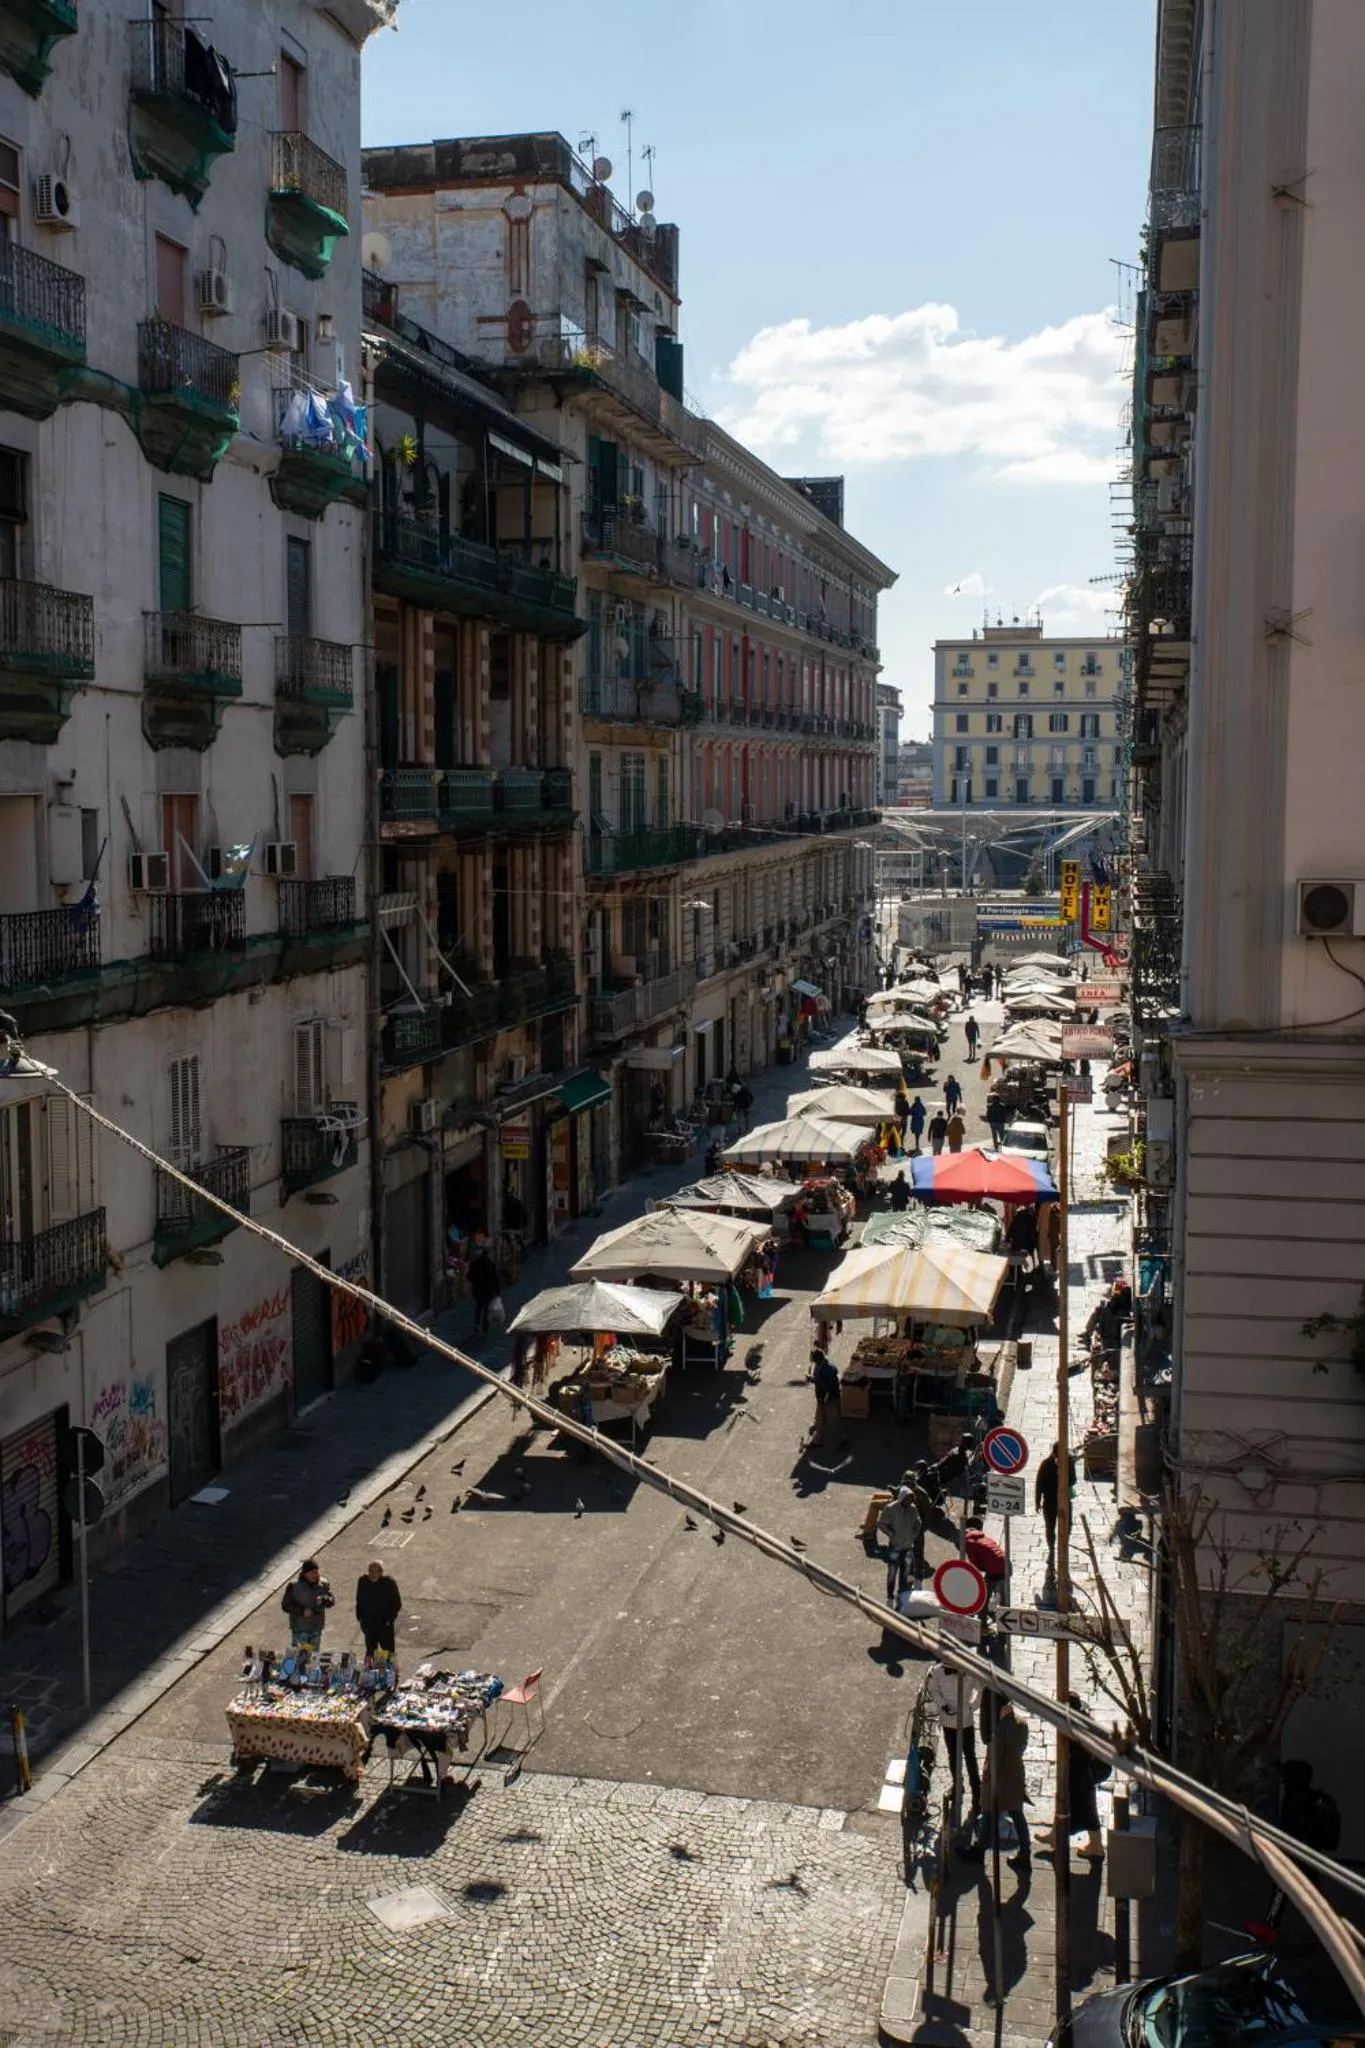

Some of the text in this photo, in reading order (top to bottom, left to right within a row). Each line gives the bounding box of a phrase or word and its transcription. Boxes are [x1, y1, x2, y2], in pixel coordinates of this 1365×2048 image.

[1063, 863, 1077, 919] HOTEL
[1063, 1025, 1087, 1036] ANTICO
[991, 1499, 1020, 1511] 0-24
